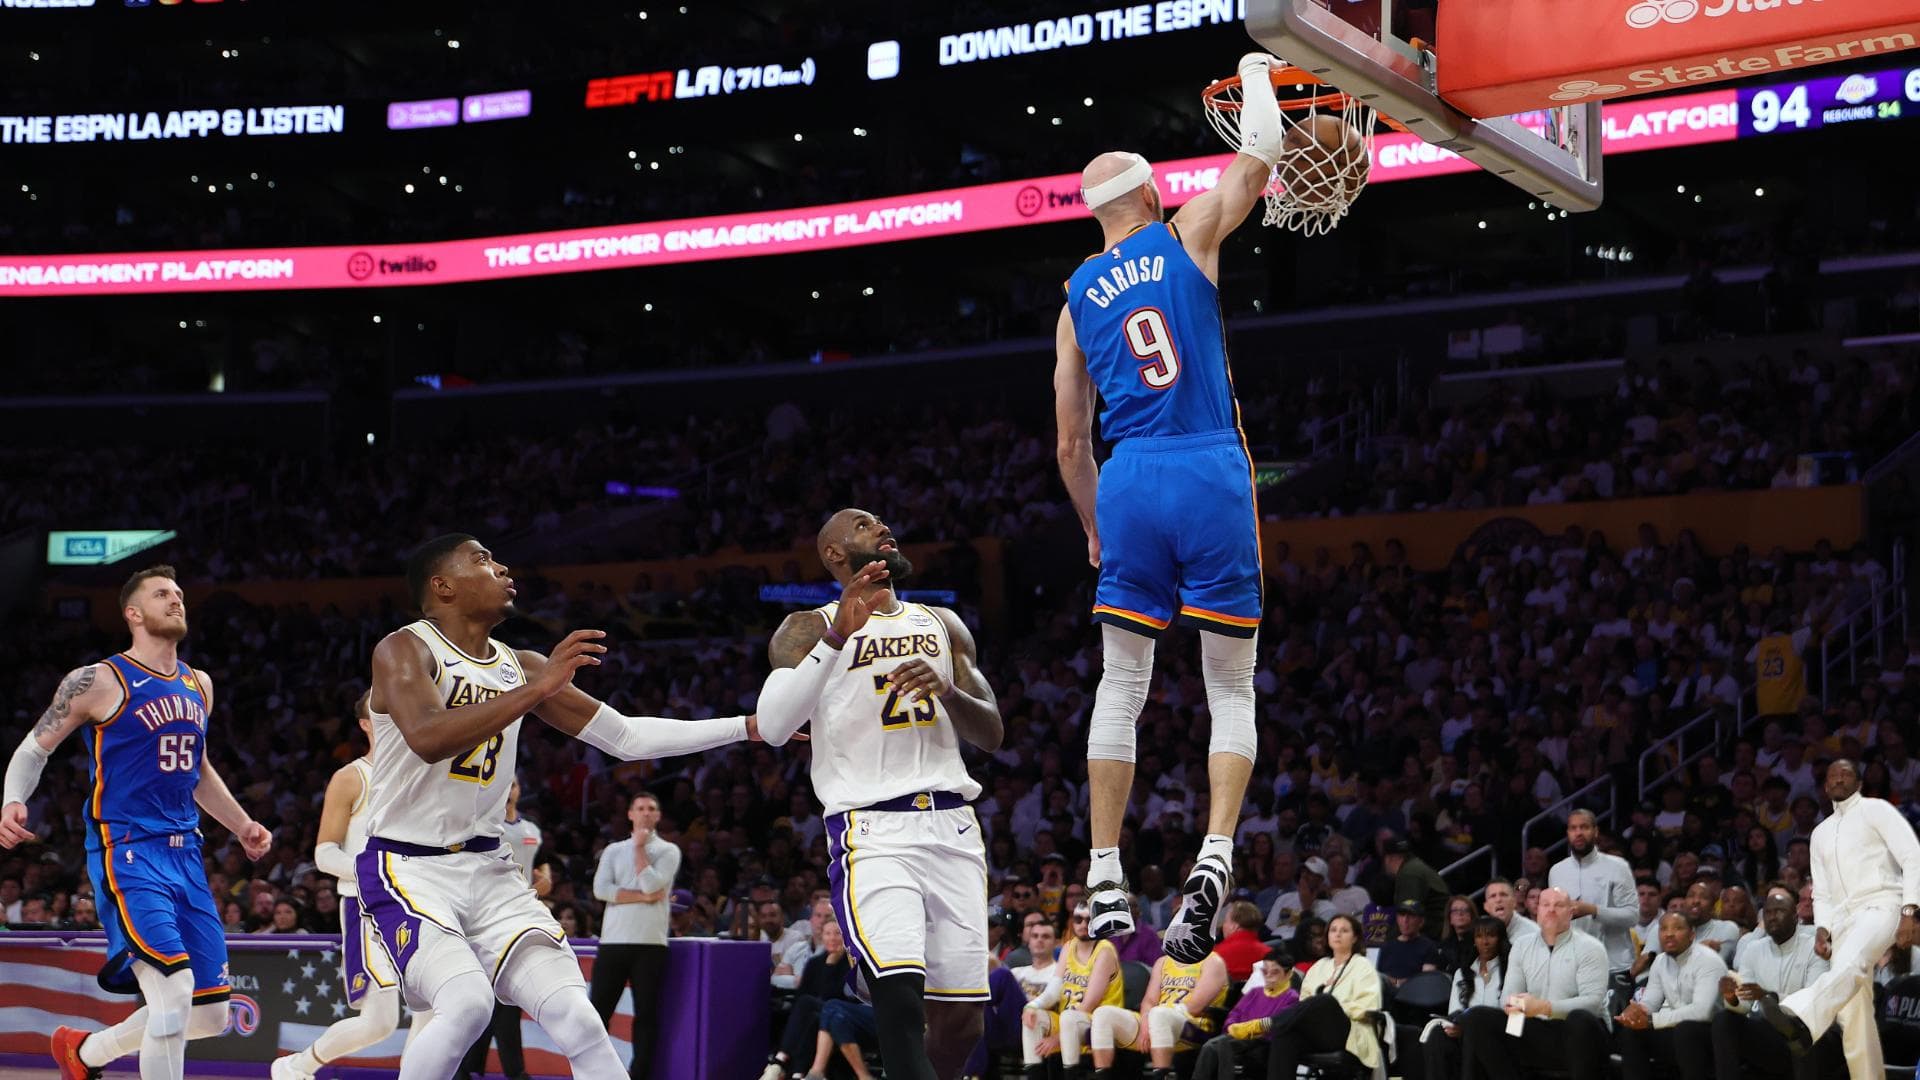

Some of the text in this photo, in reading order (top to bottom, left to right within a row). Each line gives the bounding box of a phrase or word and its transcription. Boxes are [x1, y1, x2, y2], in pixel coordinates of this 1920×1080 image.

[939, 14, 1094, 66] DOWNLOAD
[1096, 4, 1152, 41] THE
[1156, 0, 1234, 32] ESPN
[1627, 32, 1916, 89] State Farm
[585, 71, 674, 109] ESPN
[675, 65, 723, 99] LA
[0, 105, 344, 143] THE ESPN LA APP & LISTEN
[1602, 102, 1739, 140] LATFOR
[1751, 85, 1811, 132] 94
[1823, 100, 1900, 123] REBOUNDS 34
[1165, 167, 1220, 194] THE
[485, 200, 963, 267] THE CUSTOMER ENGAGEMENT PLATFORM
[0, 259, 294, 286] ENGAGEMENT PLATFORM
[380, 256, 437, 274] twilio
[1085, 254, 1165, 309] CARUSO
[1122, 306, 1182, 391] 9
[68, 540, 105, 555] UCLA
[847, 633, 941, 671] LAKERS
[133, 693, 206, 733] THUNDER
[157, 732, 198, 775] 55
[447, 731, 504, 788] 28
